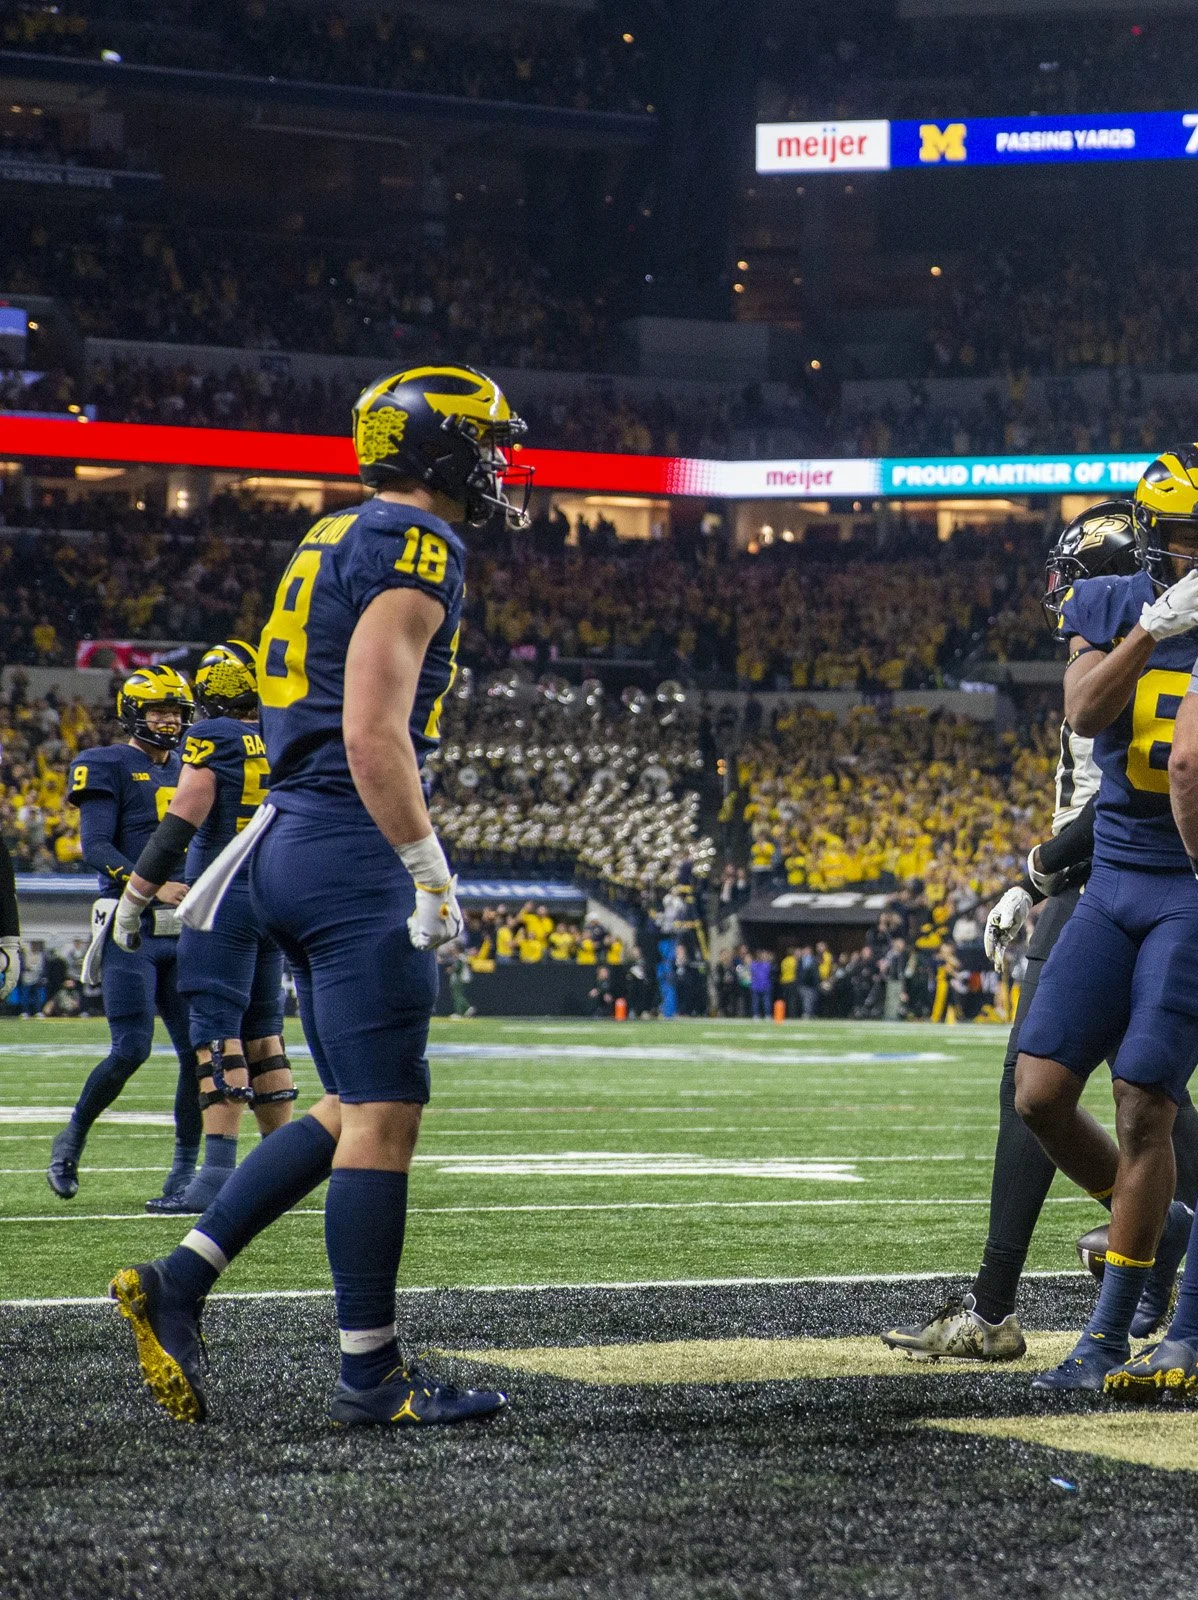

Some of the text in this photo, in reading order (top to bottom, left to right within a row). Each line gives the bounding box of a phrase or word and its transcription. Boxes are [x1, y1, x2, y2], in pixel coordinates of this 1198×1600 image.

[776, 127, 868, 164] meijer
[996, 127, 1136, 152] PASSING YARDS
[765, 464, 834, 494] meijer
[892, 465, 968, 487] PROUD
[971, 462, 1071, 486] PARTNER
[1074, 462, 1106, 484] OF
[394, 525, 449, 584] 18
[181, 735, 217, 766] 52
[72, 765, 89, 791] 9
[94, 909, 107, 926] M
